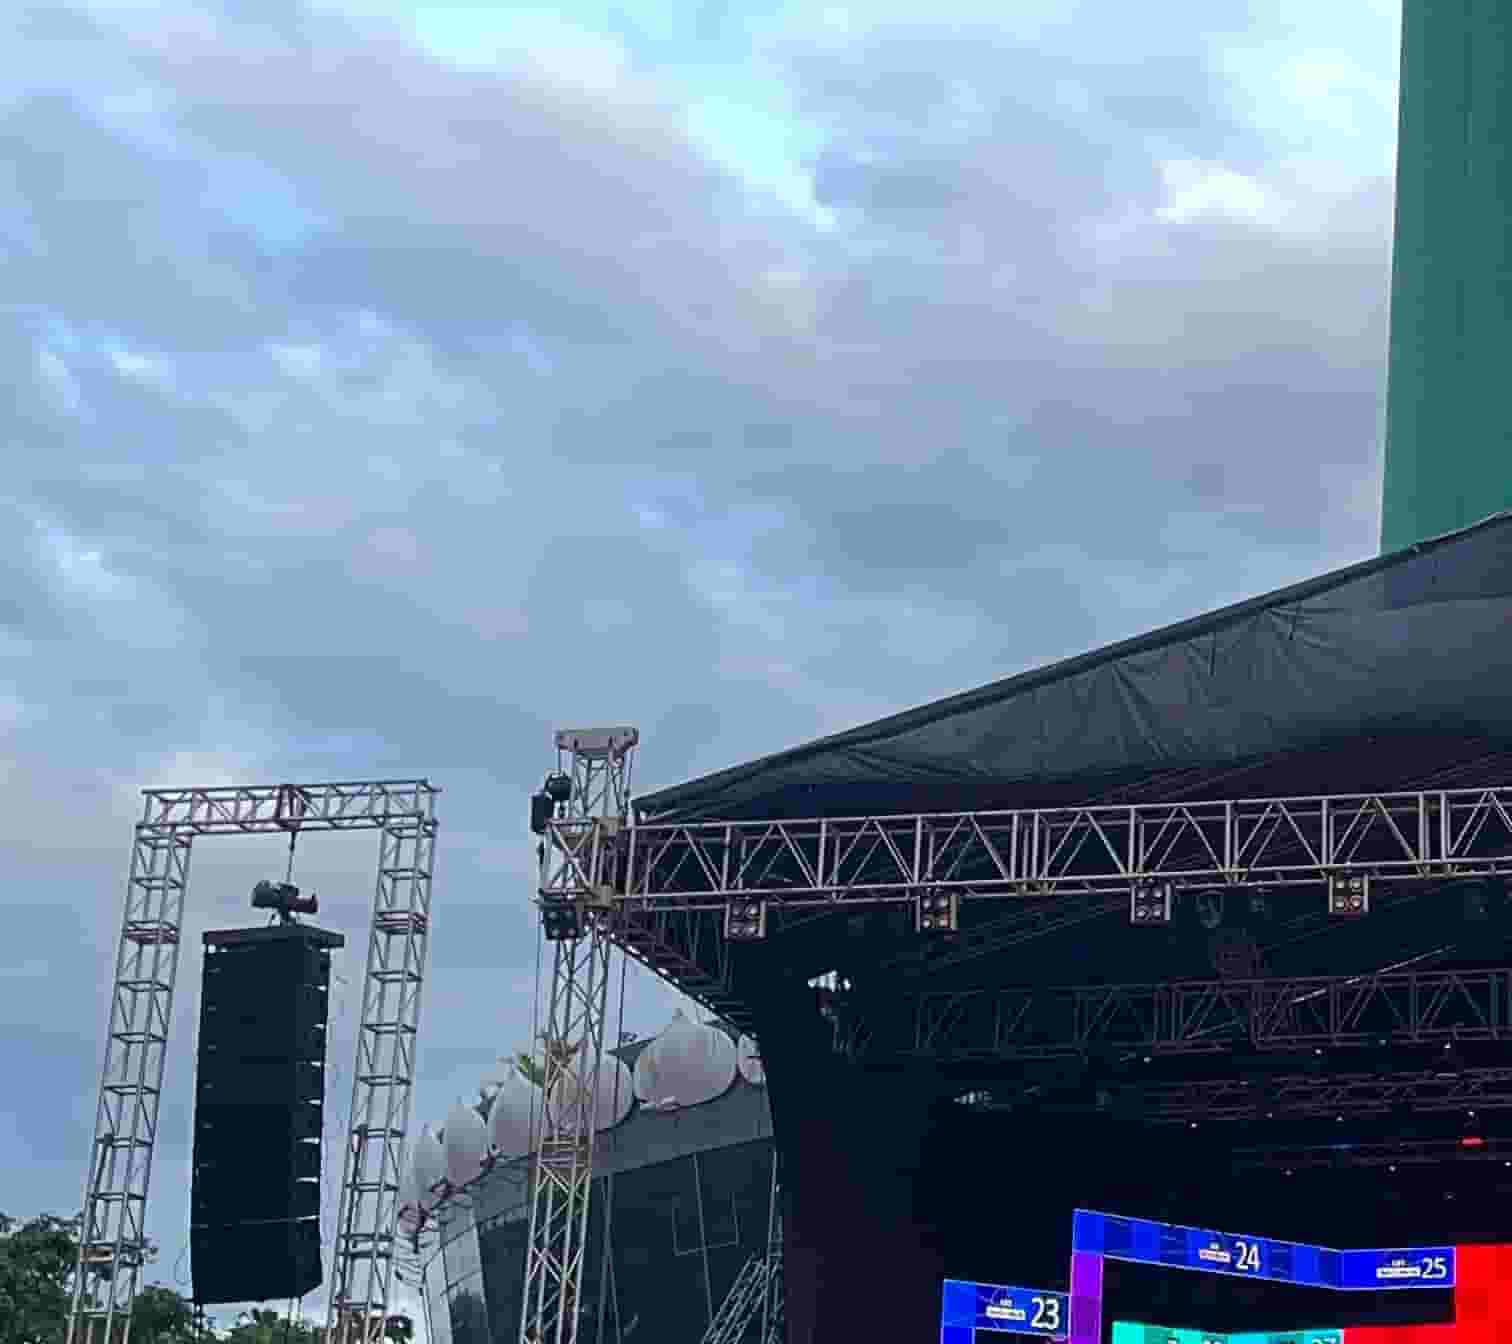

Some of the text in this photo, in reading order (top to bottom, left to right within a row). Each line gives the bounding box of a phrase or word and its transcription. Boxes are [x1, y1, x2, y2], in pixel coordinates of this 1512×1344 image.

[1235, 1242, 1260, 1272] 24
[1422, 1257, 1447, 1279] 25
[1031, 1297, 1060, 1328] 23
